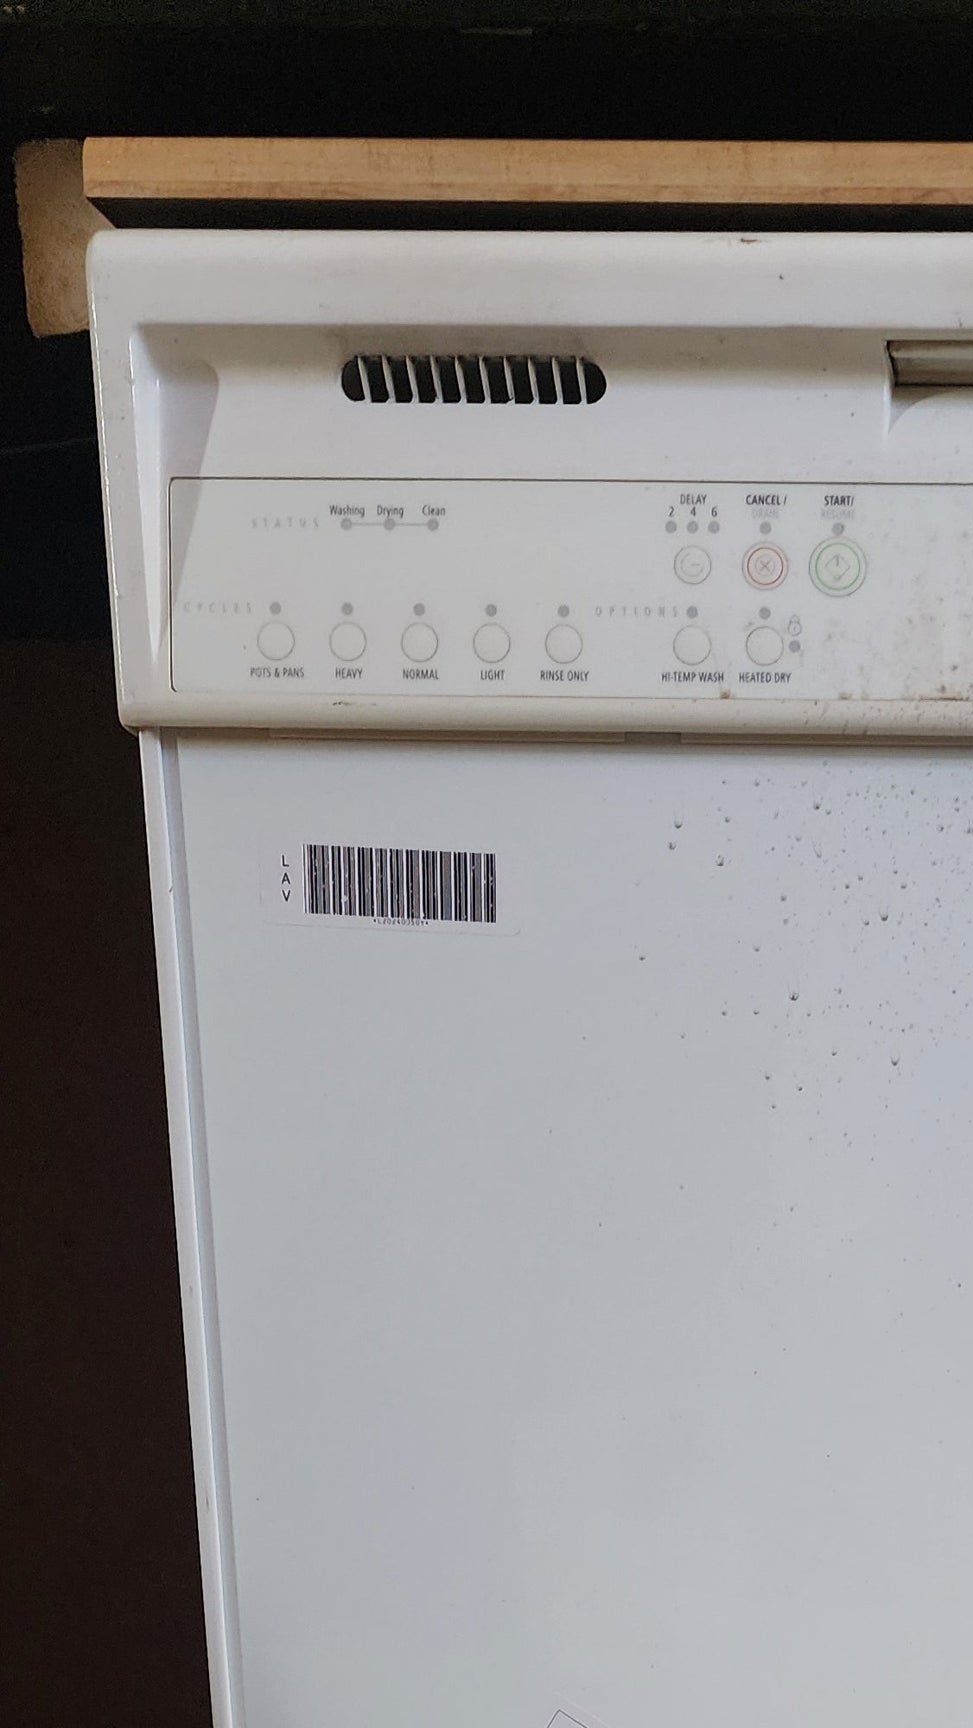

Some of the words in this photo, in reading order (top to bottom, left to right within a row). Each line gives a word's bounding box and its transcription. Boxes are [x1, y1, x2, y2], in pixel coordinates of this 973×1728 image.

[679, 494, 707, 505] DELAY
[745, 495, 781, 506] CANCEL
[329, 504, 366, 518] Washing
[376, 504, 405, 518] Drying
[421, 504, 446, 516] Clean
[668, 507, 675, 517] 2
[689, 506, 697, 517] 4
[711, 507, 718, 517] 6
[595, 606, 678, 618] OPTIONS
[250, 667, 273, 679] POTS
[282, 667, 304, 679] PANS
[335, 667, 363, 679] HEAVY
[402, 668, 439, 680] NORMAL
[480, 670, 505, 681] LIGHT
[540, 670, 564, 681] RINSE
[567, 671, 590, 682] ONLY
[661, 671, 696, 682] HI-TEMP
[698, 672, 724, 683] WASH
[738, 672, 768, 683] HEATED
[770, 672, 792, 683] DRY
